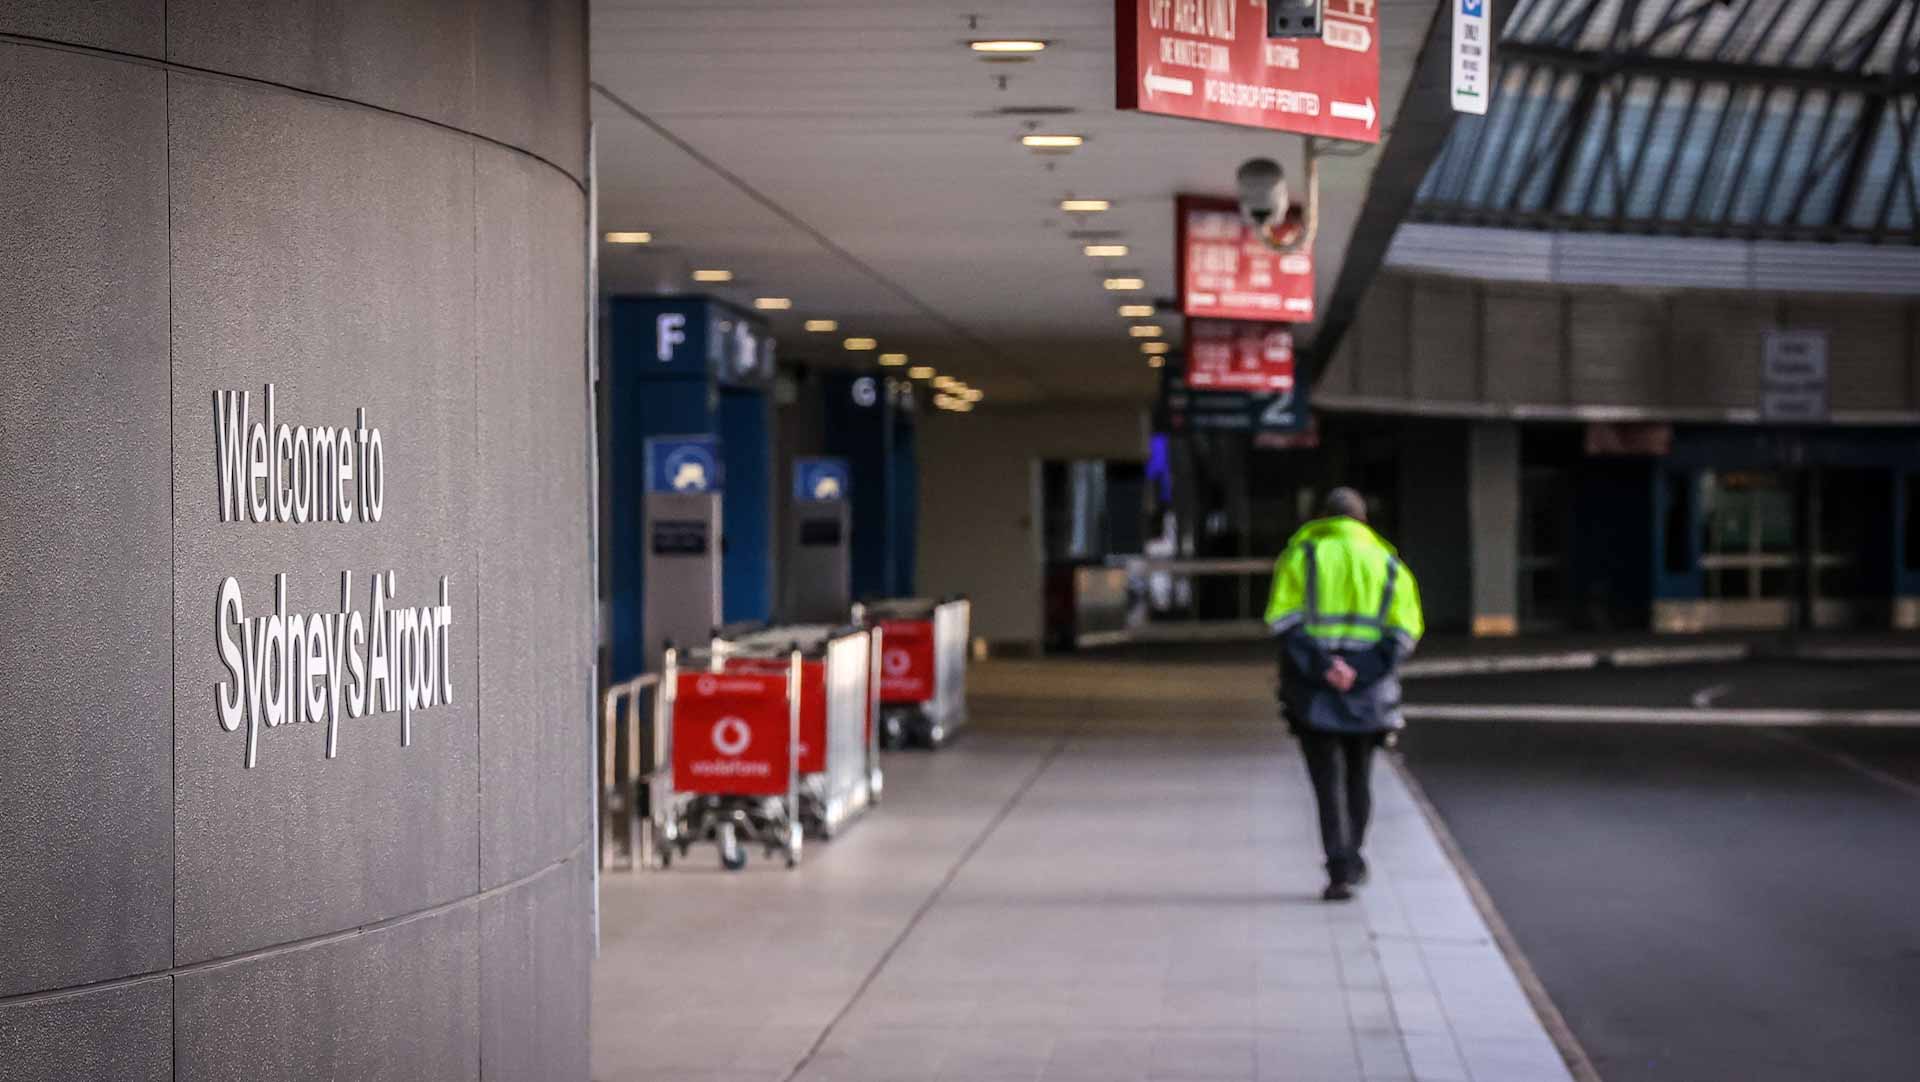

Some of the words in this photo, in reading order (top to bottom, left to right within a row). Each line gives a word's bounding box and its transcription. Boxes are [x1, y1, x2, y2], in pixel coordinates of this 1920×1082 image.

[1206, 0, 1236, 41] ONLY
[1204, 79, 1218, 102] NO
[1219, 81, 1236, 106] BUS
[656, 312, 687, 363] F
[1260, 393, 1296, 425] 2
[212, 384, 353, 523] Welcome
[355, 407, 385, 523] to
[215, 570, 366, 769] Sydney's
[364, 569, 452, 747] Airport
